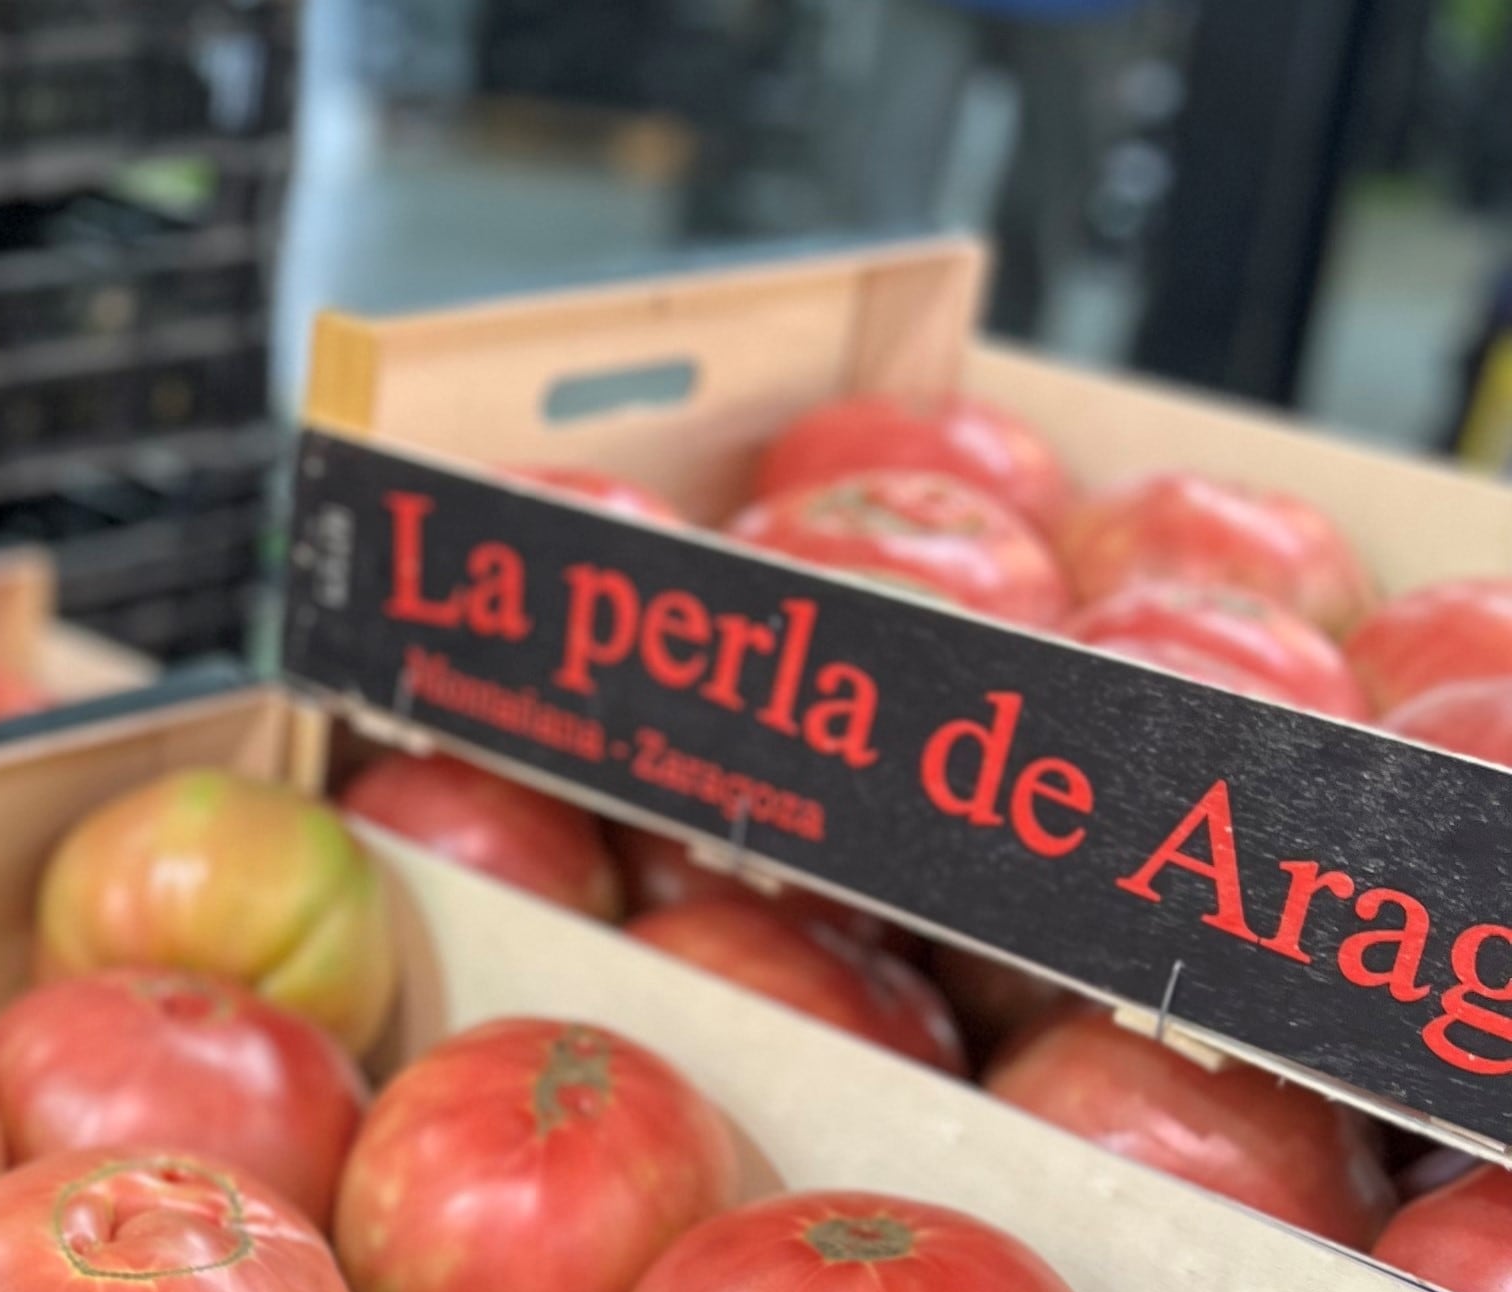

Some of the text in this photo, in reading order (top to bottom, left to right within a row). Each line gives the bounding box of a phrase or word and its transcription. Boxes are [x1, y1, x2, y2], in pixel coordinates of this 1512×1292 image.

[383, 490, 531, 641] La
[554, 561, 879, 768] perla
[920, 692, 1095, 858] de
[1114, 779, 1512, 1075] Arag
[630, 726, 826, 841] Zaragoza
